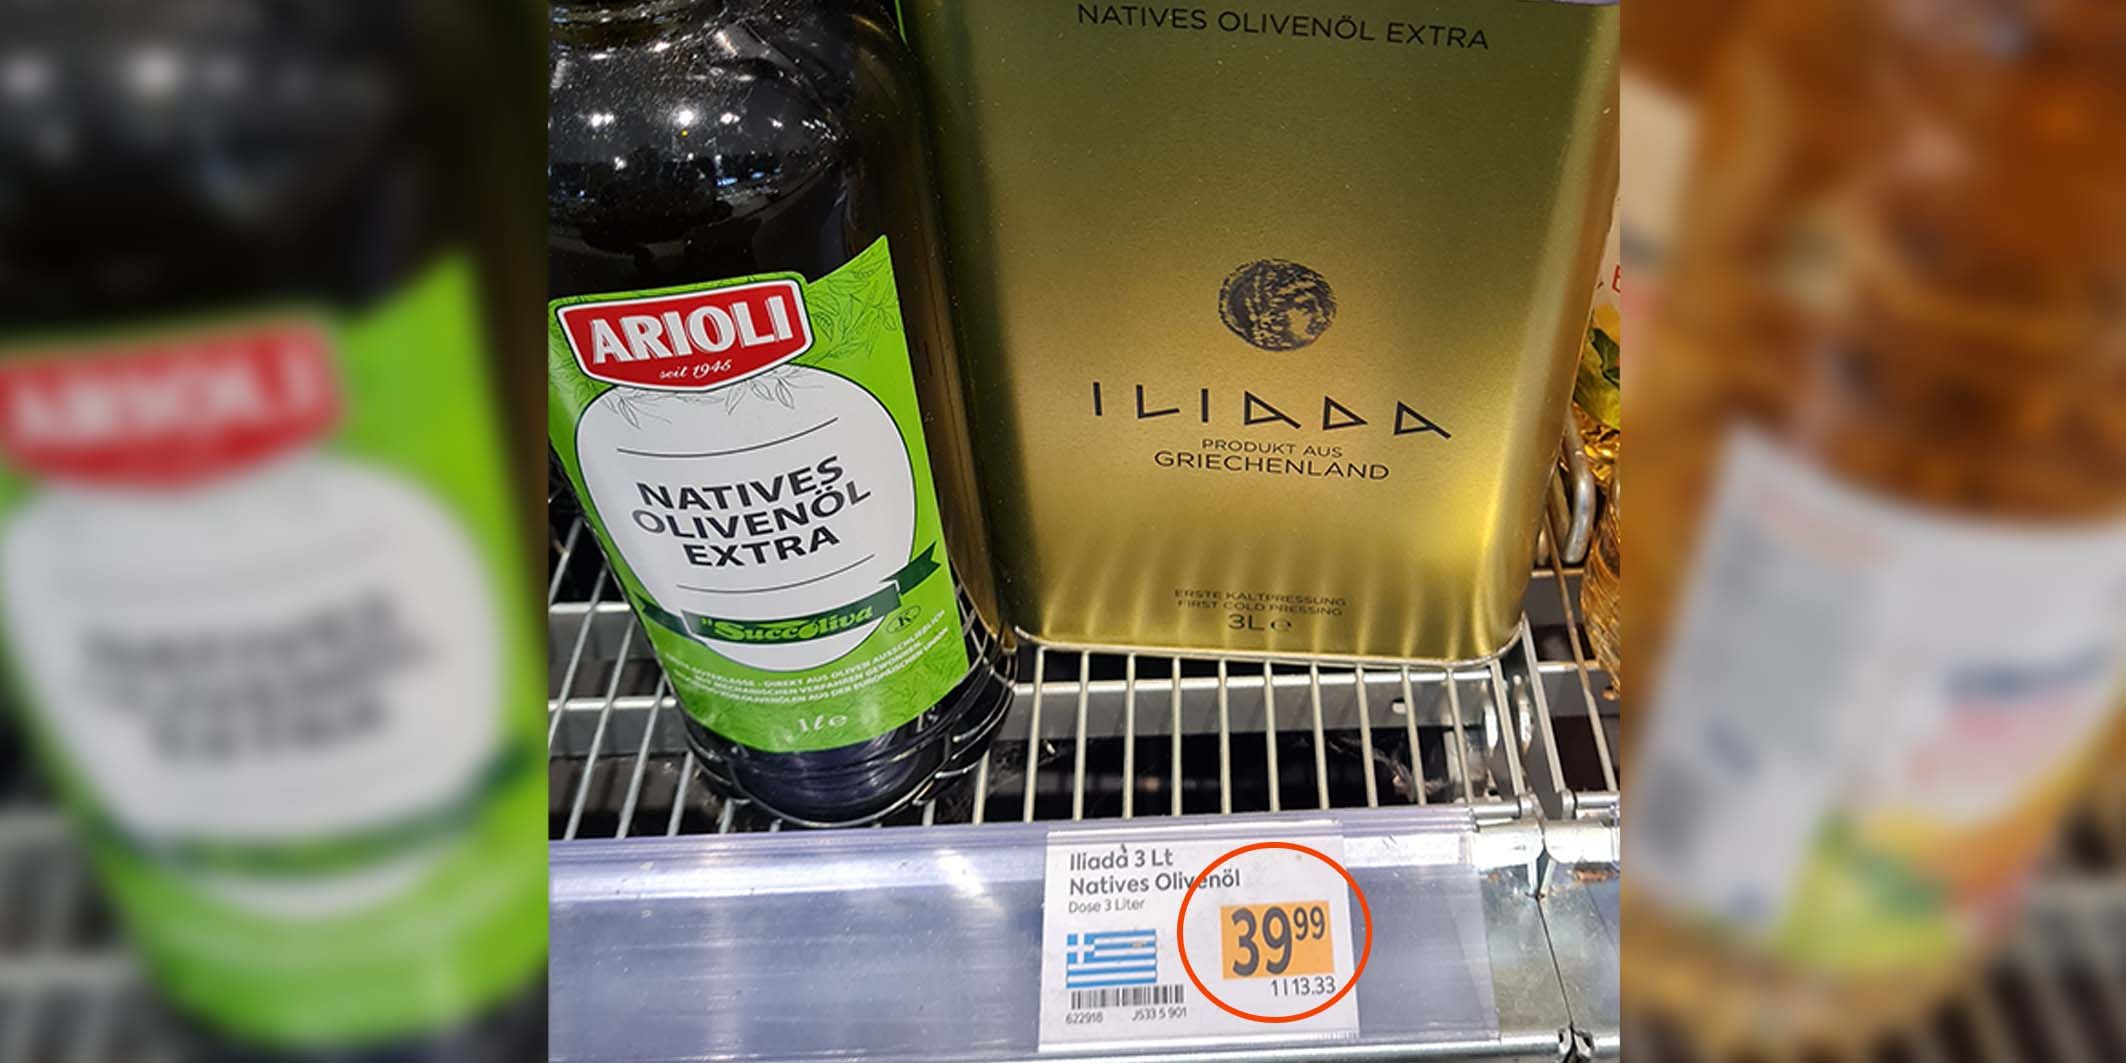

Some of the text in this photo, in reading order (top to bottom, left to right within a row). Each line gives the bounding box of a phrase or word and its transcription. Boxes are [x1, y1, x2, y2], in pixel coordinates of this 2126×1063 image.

[1077, 3, 1490, 51] NATIVES OLIVENÖL EXTRA
[589, 295, 794, 365] ARIOLI
[659, 365, 688, 380] seit
[1093, 381, 1452, 440] ILIADA
[1201, 438, 1343, 458] PRODUKT AUS
[1153, 450, 1390, 481] GRIECHENLAND
[636, 455, 844, 512] NATIVES
[631, 480, 872, 540] OLIVENÖL
[682, 525, 841, 568] EXTRA
[1174, 589, 1347, 607] ERSTE KALTPRESSUNG
[1177, 600, 1344, 617] FIRST COLD PRESSING
[1227, 613, 1265, 631] 3L
[1069, 847, 1174, 871] Iliada 3 Lt
[1068, 868, 1241, 896] Natives Olivenöl
[1068, 898, 1146, 913] Dose 3 Liter
[1292, 975, 1336, 996] 13.33
[1065, 1011, 1104, 1024] 622918
[1167, 1006, 1187, 1019] 901
